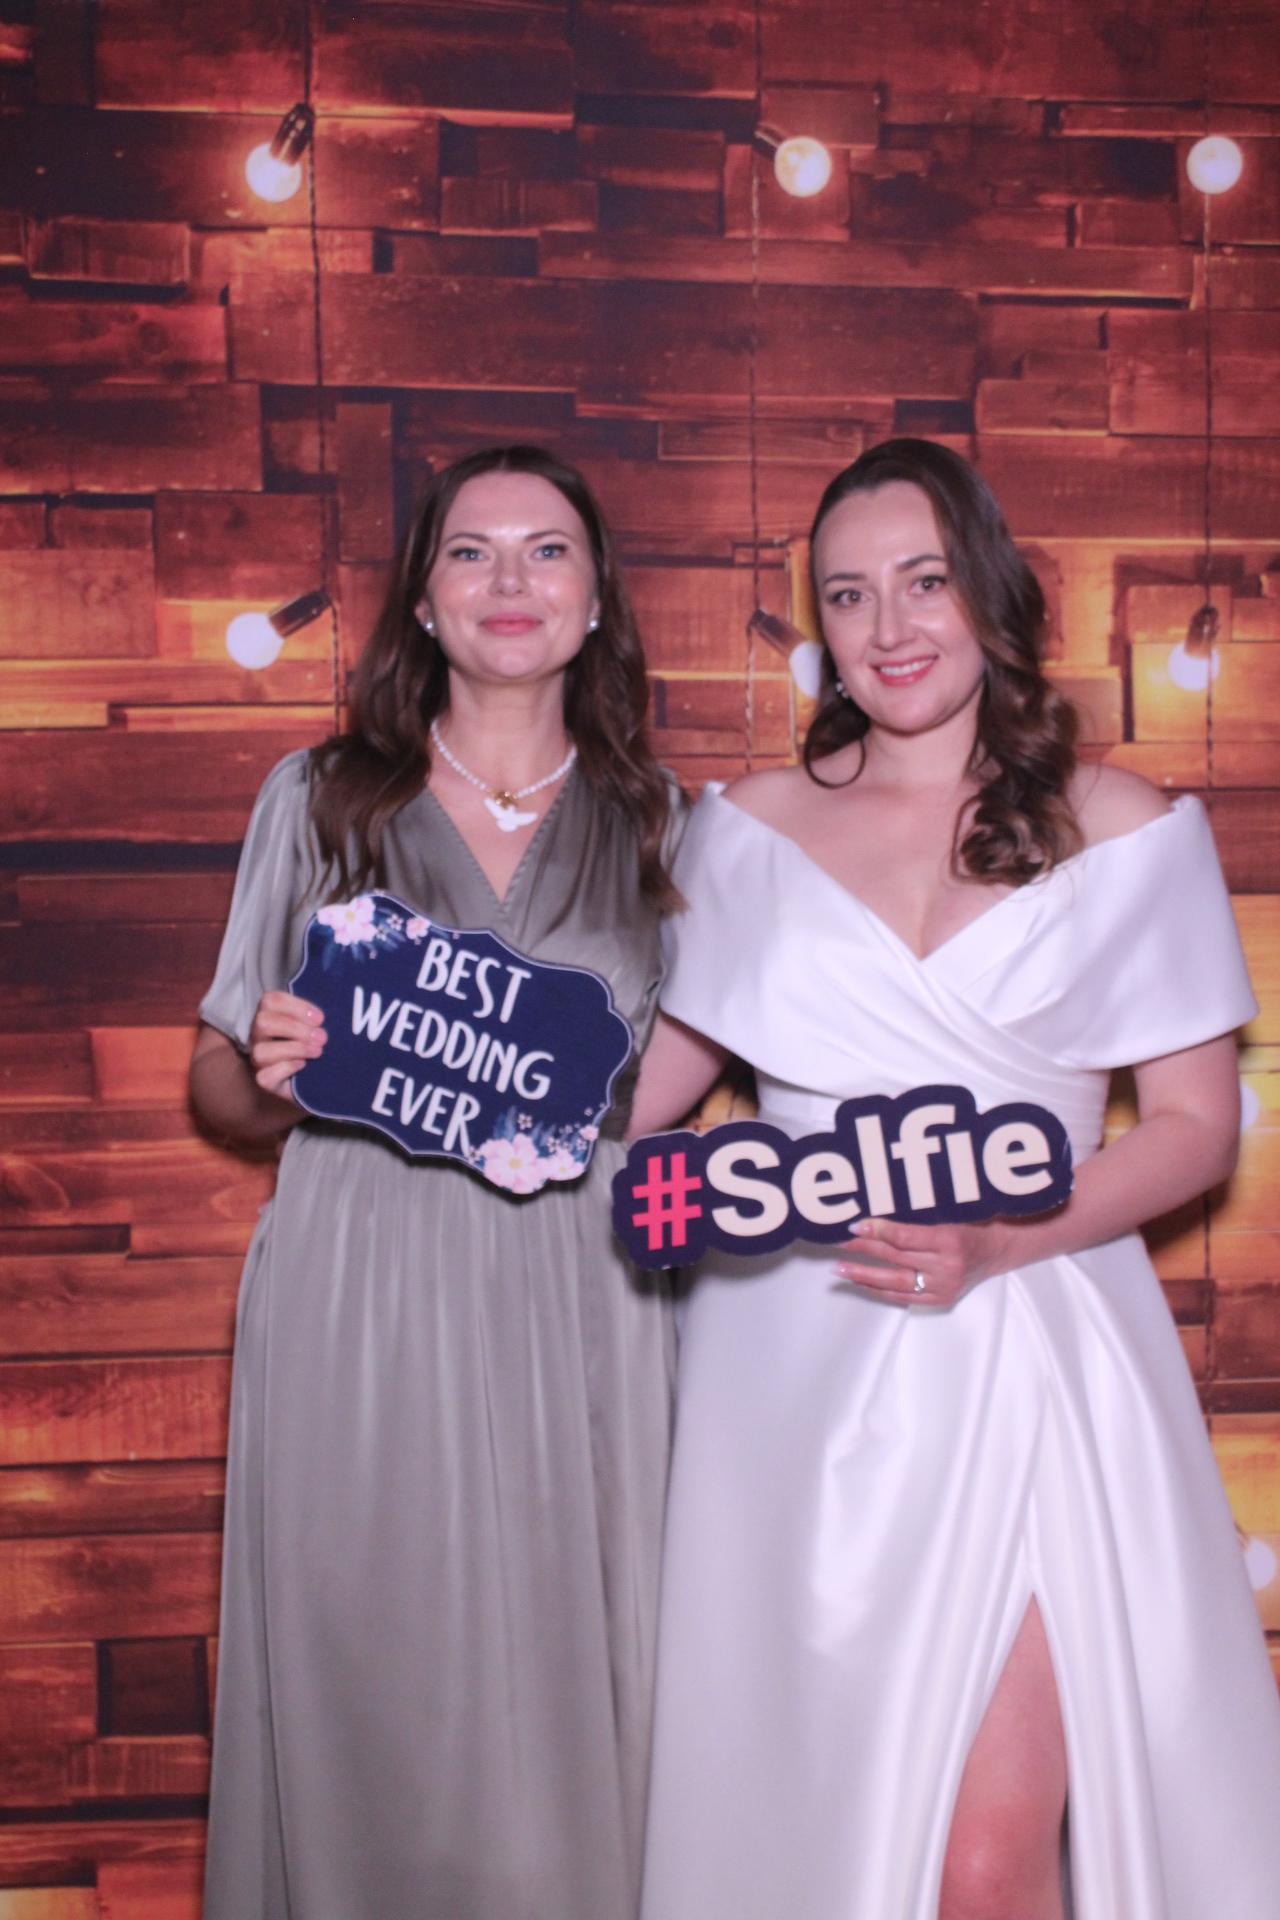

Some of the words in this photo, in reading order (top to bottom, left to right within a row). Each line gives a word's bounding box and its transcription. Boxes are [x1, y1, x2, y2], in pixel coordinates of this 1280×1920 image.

[416, 937, 532, 1023] BEST
[351, 985, 554, 1101] WEDDING
[371, 1067, 481, 1159] EVER
[632, 1103, 1054, 1251] #Selfie
